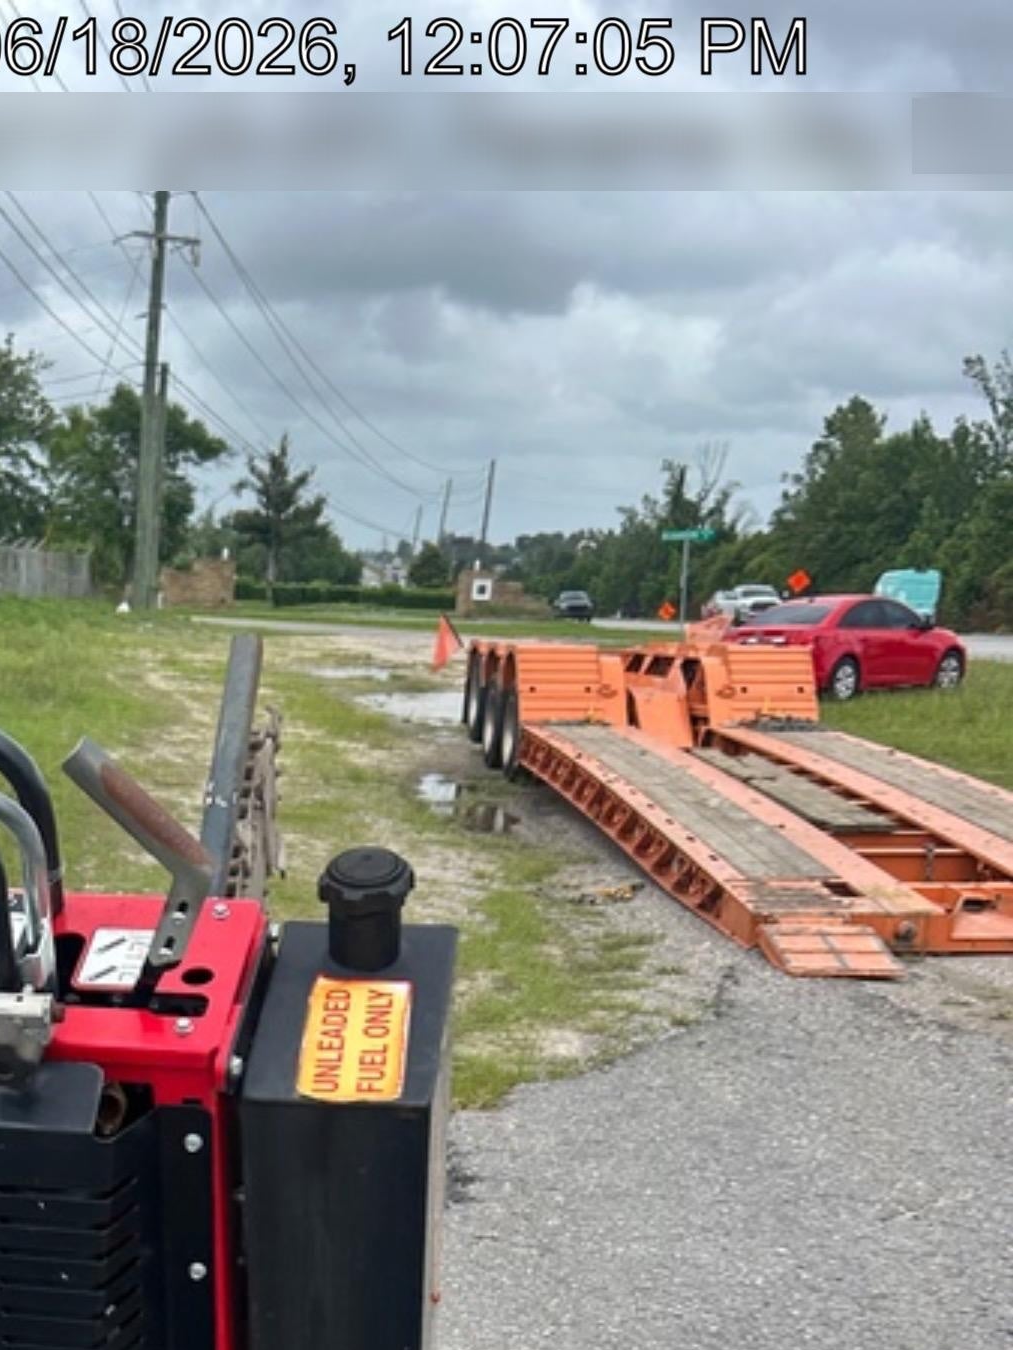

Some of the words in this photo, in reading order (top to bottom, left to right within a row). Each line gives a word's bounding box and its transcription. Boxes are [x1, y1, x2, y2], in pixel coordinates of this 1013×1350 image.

[362, 988, 393, 1038] ONLY
[312, 989, 351, 1093] UNLEADED
[357, 1043, 389, 1093] FUEL
